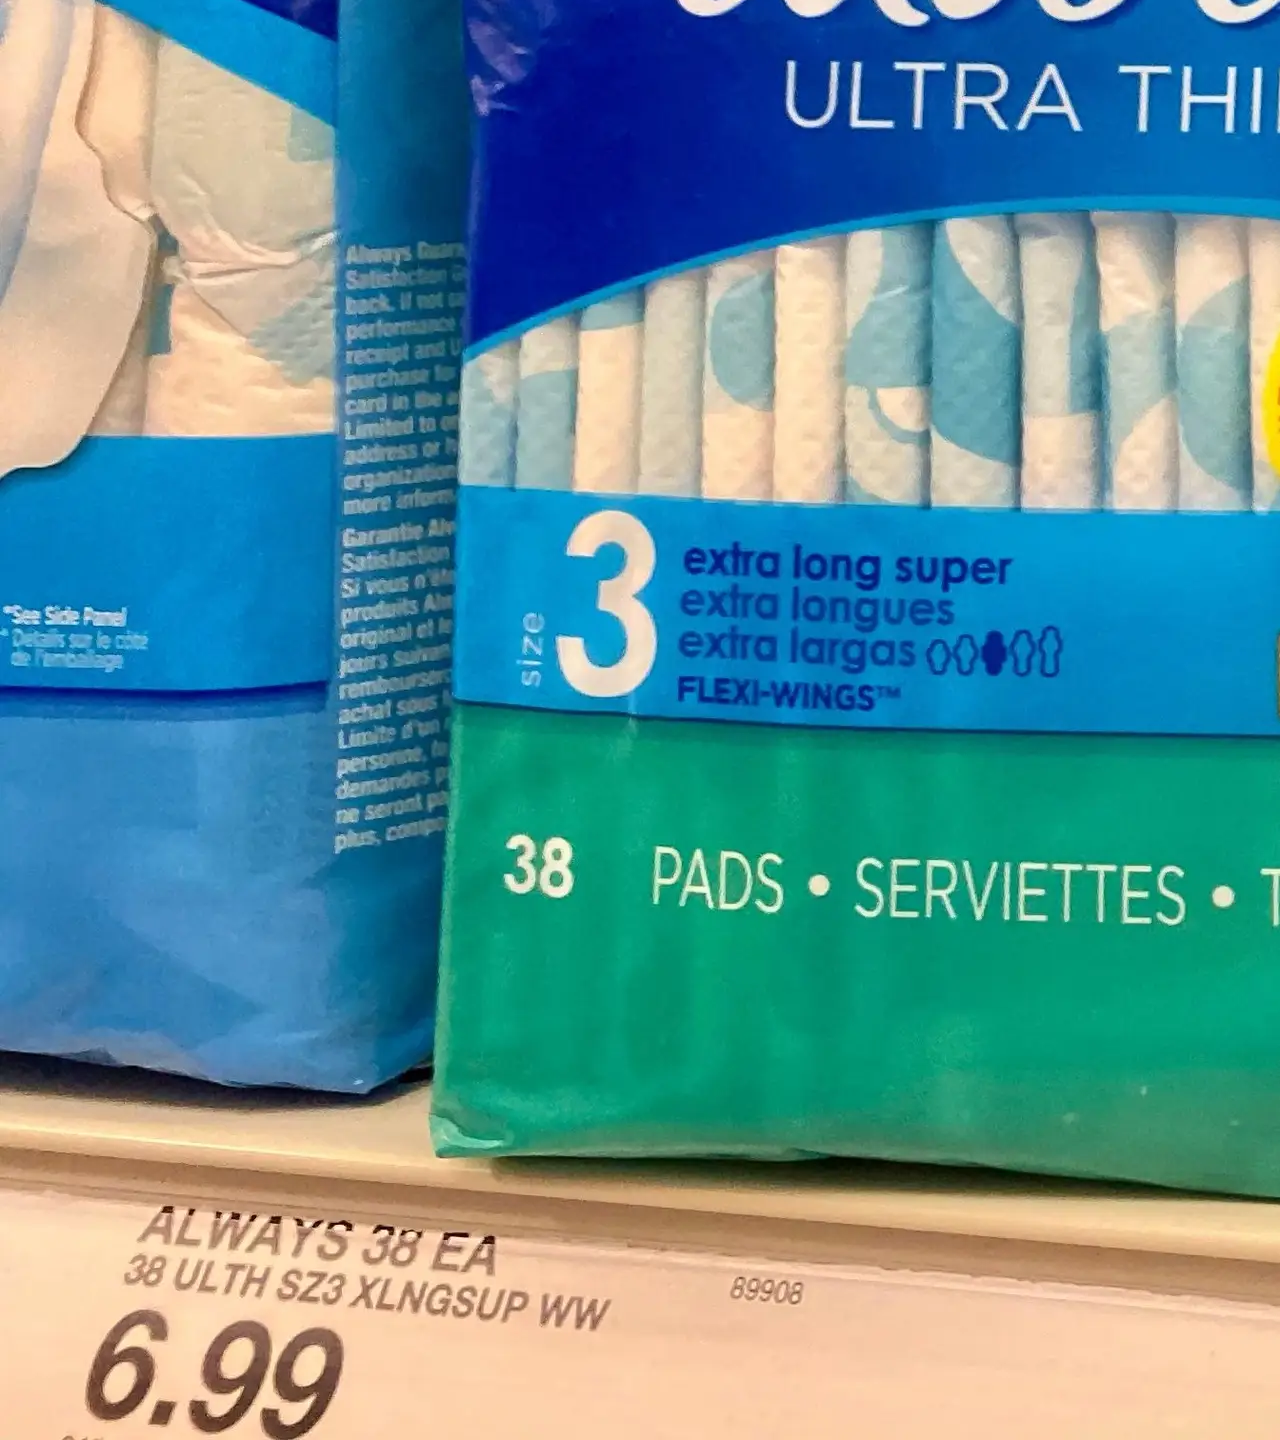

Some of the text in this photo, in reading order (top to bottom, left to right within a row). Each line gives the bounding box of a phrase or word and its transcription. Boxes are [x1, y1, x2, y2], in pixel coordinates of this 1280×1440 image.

[784, 60, 1083, 133] ULTRA
[346, 244, 412, 266] Always
[414, 340, 446, 360] and
[345, 393, 387, 415] card
[393, 392, 409, 410] in
[344, 415, 436, 440] Limited to
[344, 443, 417, 465] address
[344, 495, 391, 515] more
[343, 522, 424, 547] Garantie
[683, 541, 1013, 591] extra long super
[365, 576, 408, 594] vous
[44, 604, 80, 625] Side
[83, 606, 128, 627] Panel
[556, 509, 657, 697] 3
[680, 584, 955, 626] extra longues
[341, 621, 412, 649] original
[521, 612, 544, 688] size
[678, 626, 916, 673] extra largas
[503, 832, 575, 900] 38
[652, 844, 785, 915] PADS
[854, 855, 1187, 927] SERVIETTES
[138, 1205, 498, 1276] ALWAYS 38 EA
[123, 1255, 612, 1331] 38 ULTH SZ3 XLNGSUP WW
[730, 1276, 803, 1306] 89908
[85, 1309, 344, 1440] 6.99
